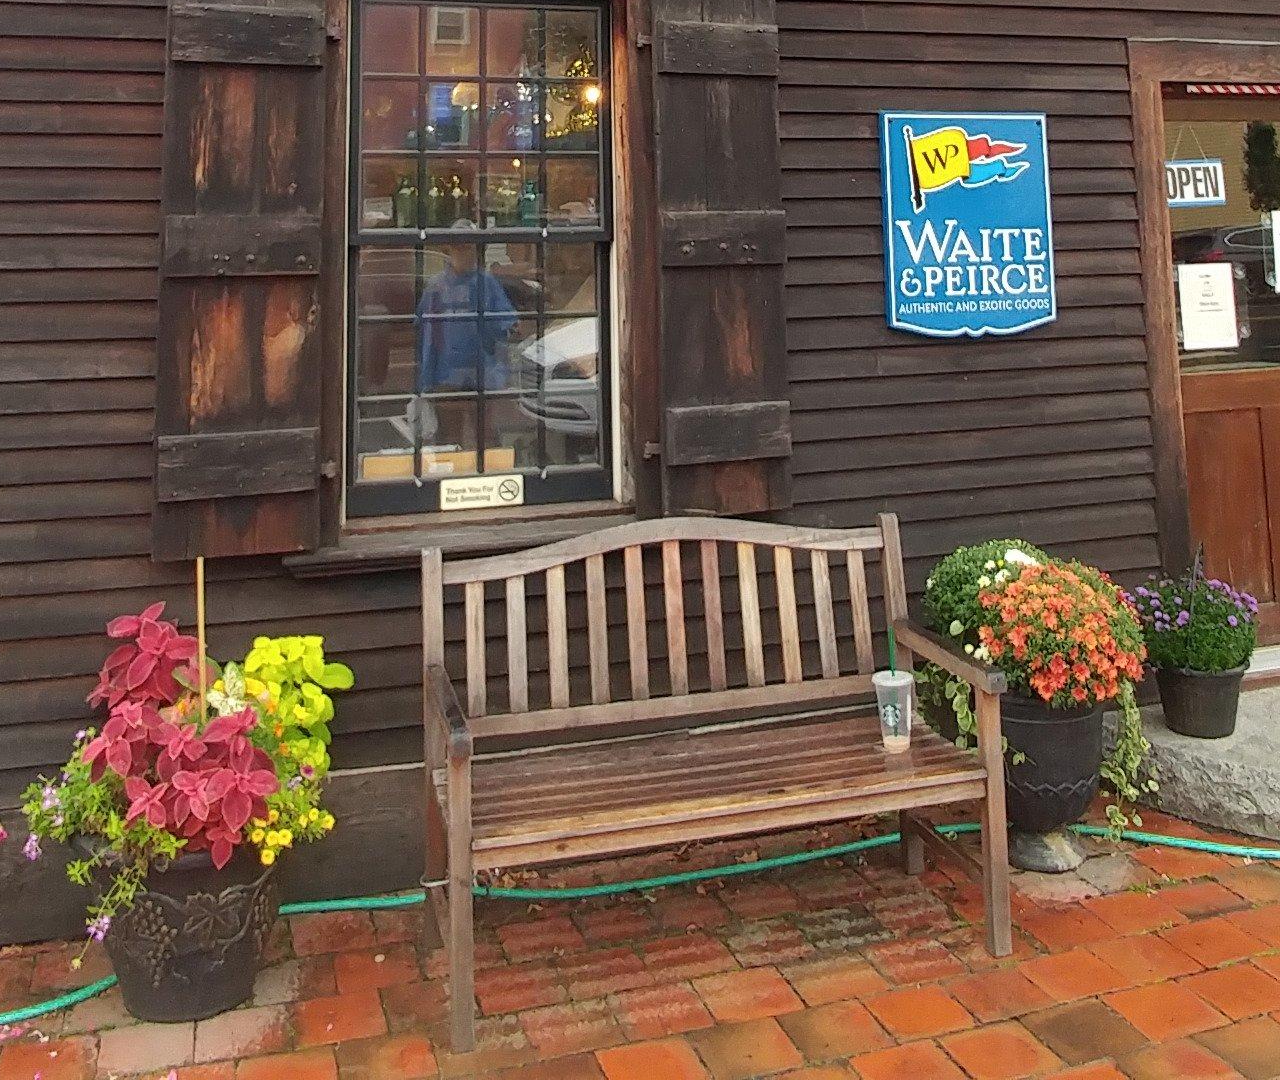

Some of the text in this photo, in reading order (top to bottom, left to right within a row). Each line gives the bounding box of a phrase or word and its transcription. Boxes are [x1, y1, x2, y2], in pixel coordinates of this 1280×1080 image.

[922, 144, 959, 174] WP
[1165, 166, 1220, 200] OPEN
[895, 219, 1046, 264] WAITE
[899, 298, 1050, 314] AUTHENTIC AND EXOTIC GOODS
